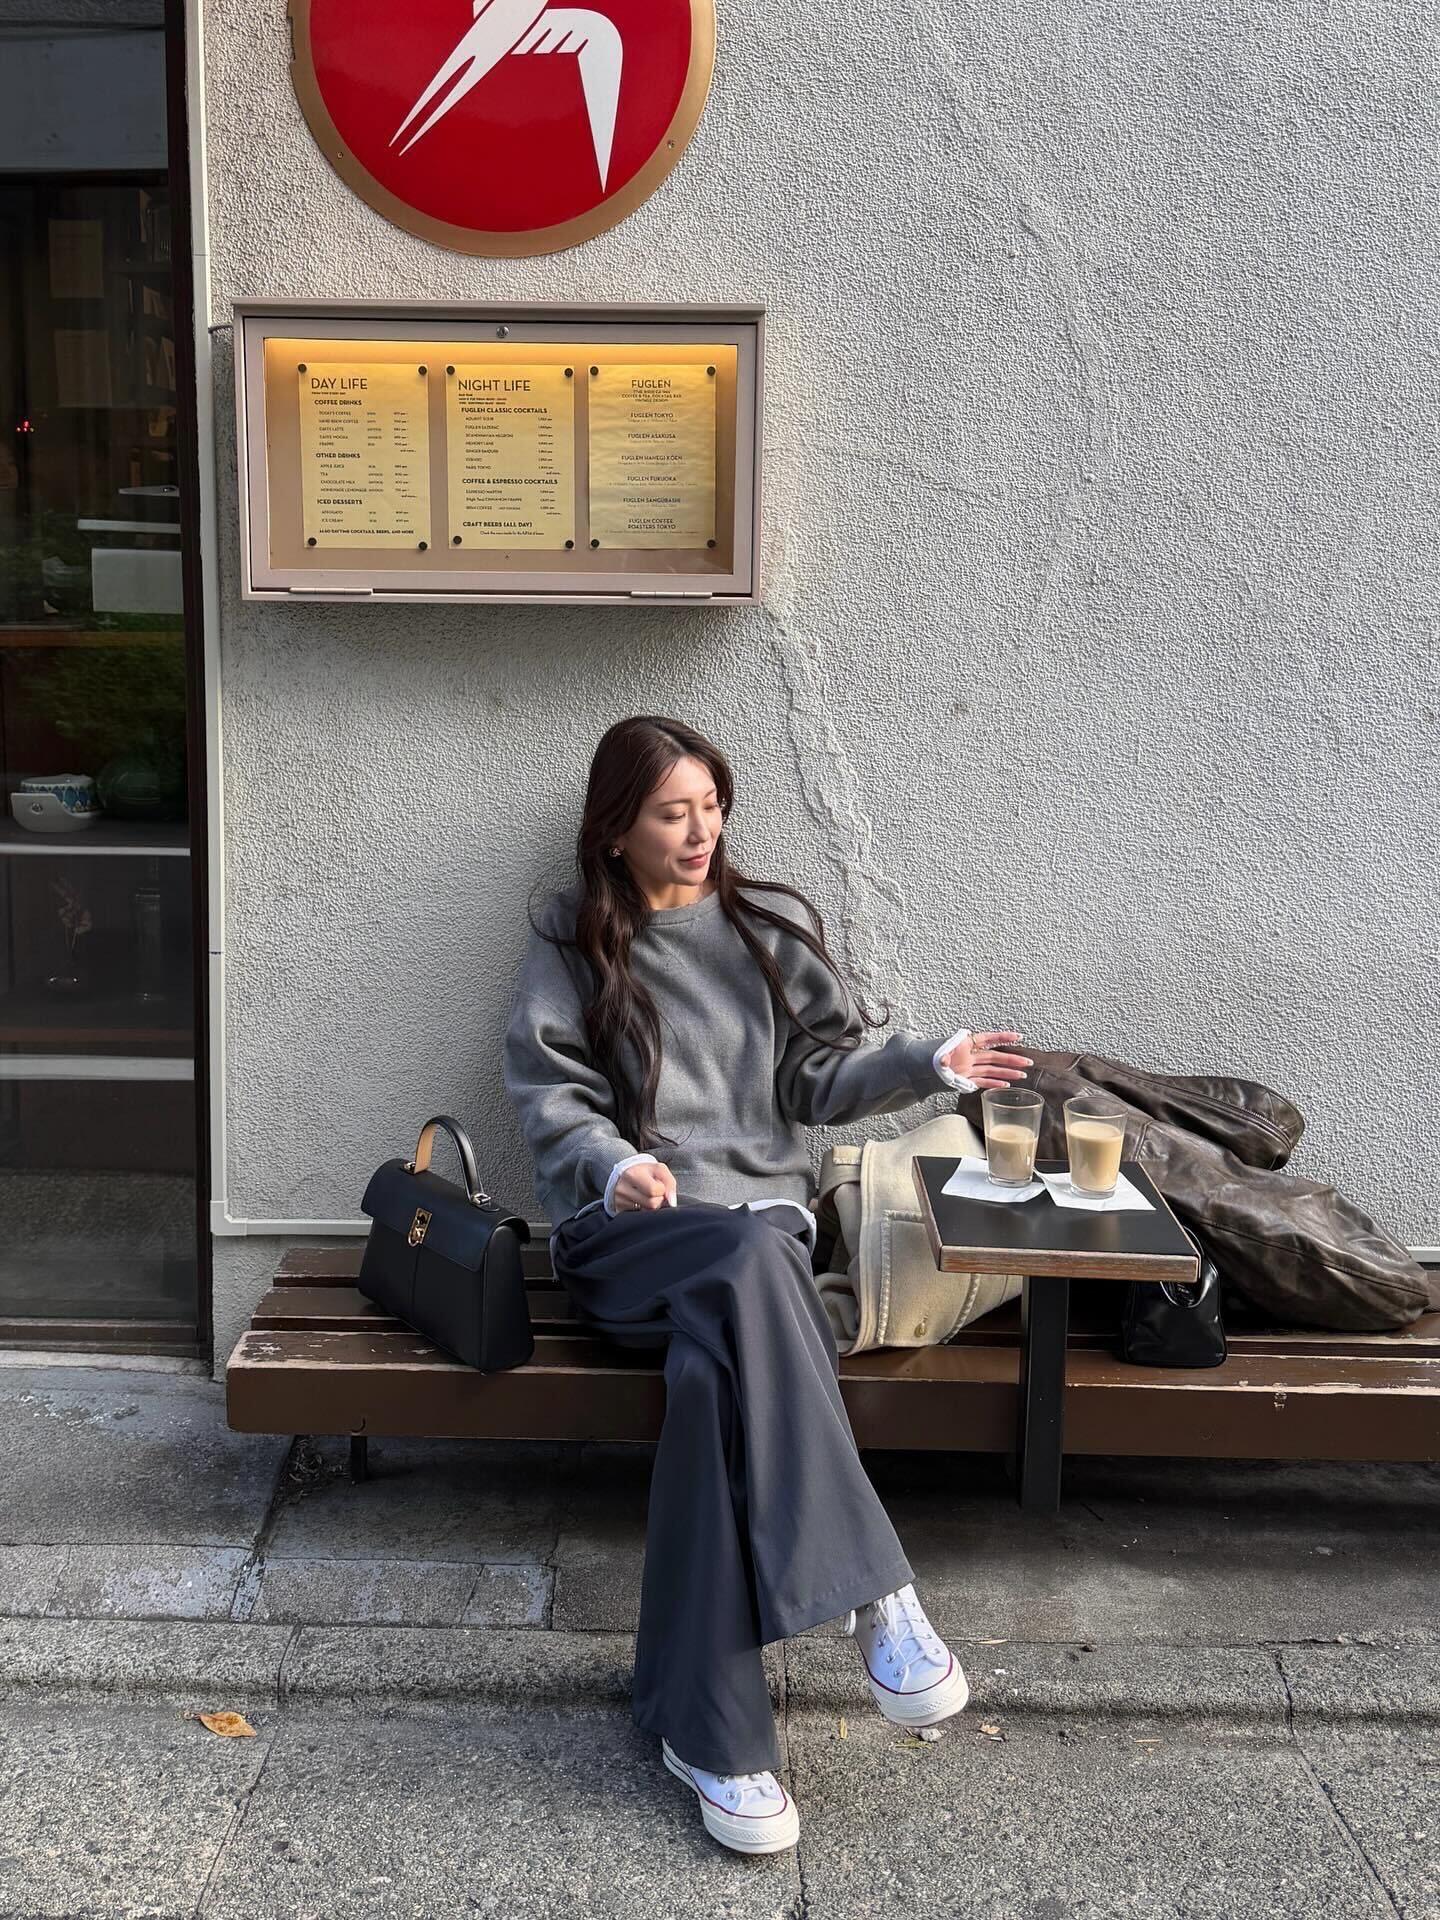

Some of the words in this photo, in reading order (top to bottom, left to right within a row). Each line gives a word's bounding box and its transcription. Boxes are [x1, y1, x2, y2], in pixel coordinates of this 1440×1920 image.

[311, 378, 337, 390] DAY
[341, 378, 368, 390] LIFE
[458, 380, 500, 391] NIGHT
[504, 380, 531, 391] LIFE
[631, 380, 671, 389] FUGLEN
